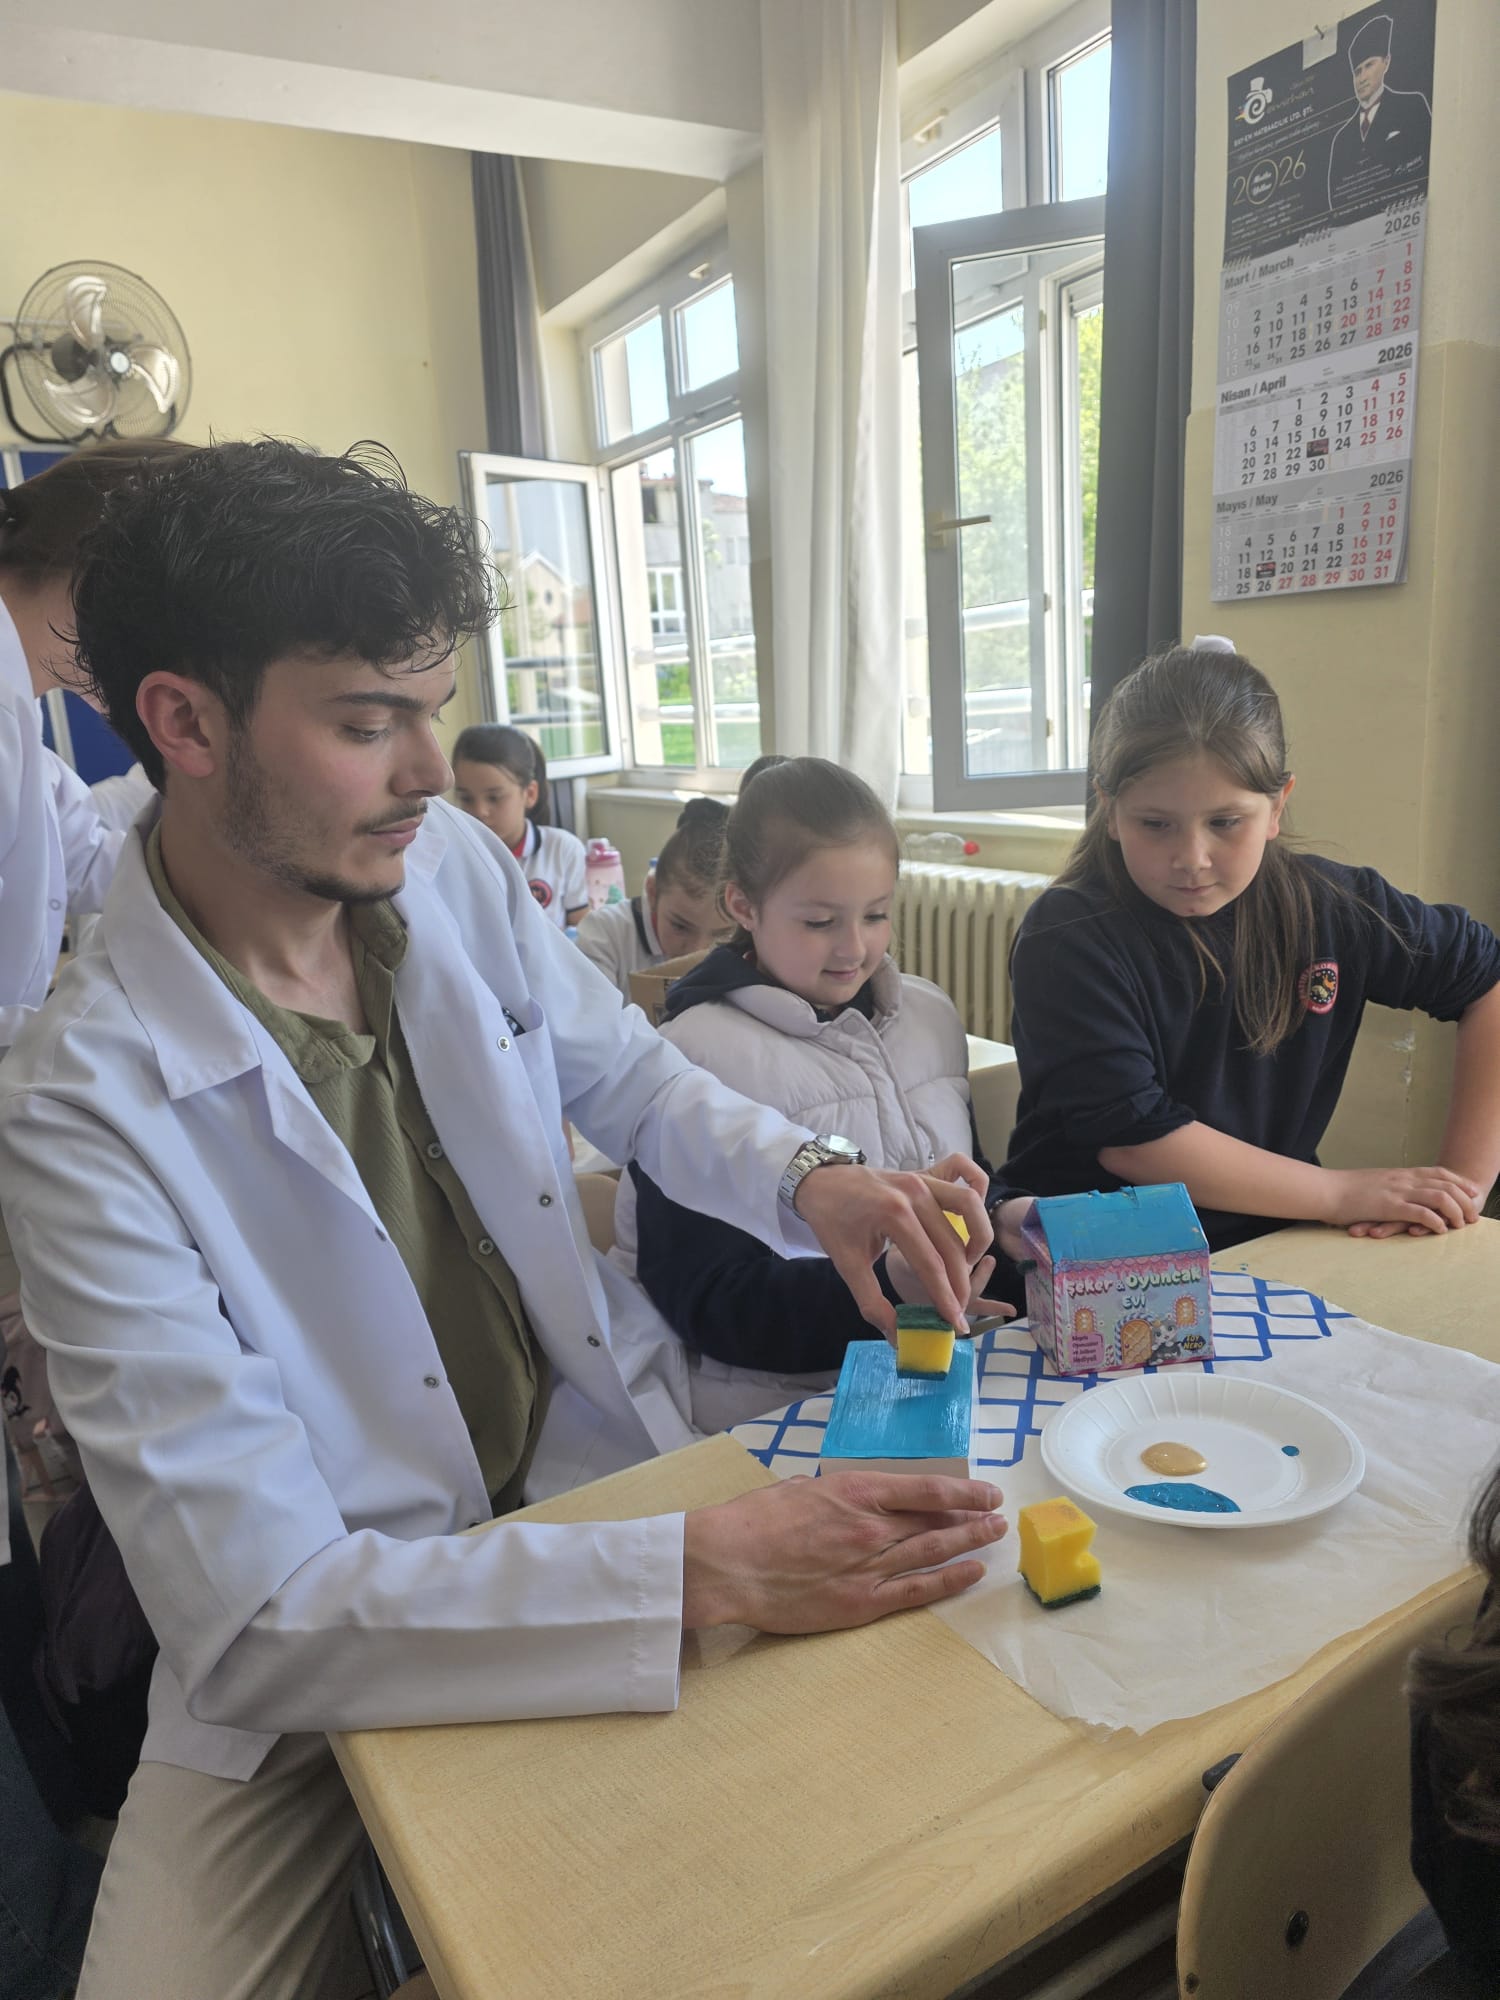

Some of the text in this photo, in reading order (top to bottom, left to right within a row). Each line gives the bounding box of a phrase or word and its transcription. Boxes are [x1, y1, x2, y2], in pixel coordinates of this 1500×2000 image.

[1233, 149, 1306, 205] 2026
[1384, 211, 1421, 236] 2026
[1406, 241, 1412, 256] 1
[1224, 272, 1249, 290] Mart
[1259, 256, 1294, 278] March
[1254, 309, 1261, 322] 2
[1276, 301, 1284, 315] 3
[1300, 293, 1308, 306] 4
[1325, 286, 1333, 300] 5
[1350, 277, 1358, 292] 6
[1376, 268, 1385, 283] 7
[1404, 260, 1412, 275] 8
[1254, 325, 1260, 338] 9
[1269, 318, 1283, 333] 10
[1293, 311, 1305, 326] 11
[1317, 303, 1332, 319] 12
[1343, 295, 1358, 311] 13
[1368, 287, 1384, 303] 14
[1395, 279, 1411, 295] 15
[1247, 342, 1260, 356] 16
[1269, 334, 1283, 349] 17
[1292, 327, 1306, 342] 18
[1317, 320, 1332, 336] 19
[1341, 312, 1357, 329] 20
[1367, 304, 1382, 321] 21
[1393, 296, 1410, 314] 22
[1290, 344, 1306, 360] 25
[1314, 338, 1331, 353] 26
[1340, 329, 1356, 346] 27
[1366, 321, 1382, 339] 28
[1392, 314, 1410, 332] 29
[1377, 341, 1412, 364] 2026
[1220, 387, 1251, 404] Nisan
[1259, 375, 1287, 394] April
[1296, 372, 1406, 410] 1 2 3 4 5
[1250, 390, 1406, 437] 6 7 8 9 10 11 12
[1244, 407, 1404, 454] 13 14 15 16 17 18 19
[1242, 456, 1256, 470] 20
[1263, 451, 1276, 465] 21
[1286, 446, 1301, 461] 22
[1335, 436, 1351, 451] 24
[1360, 431, 1377, 446] 25
[1386, 425, 1403, 440] 26
[1241, 458, 1325, 485] 27 28 29 30
[1369, 469, 1404, 488] 2026
[1216, 500, 1247, 514] Mayıs
[1256, 494, 1278, 506] May
[1339, 506, 1344, 519] 1
[1362, 502, 1370, 515] 2
[1388, 497, 1397, 511] 3
[1238, 552, 1250, 564] 11
[1260, 549, 1274, 561] 12
[1282, 546, 1295, 559] 13
[1304, 542, 1319, 555] 14
[1328, 539, 1343, 552] 15
[1353, 535, 1368, 549] 16
[1378, 531, 1394, 545] 17
[1244, 536, 1252, 548] 4
[1267, 533, 1275, 546] 5
[1290, 530, 1297, 542] 6
[1312, 526, 1320, 539] 7
[1336, 522, 1345, 535] 8
[1361, 518, 1369, 531] 9
[1379, 515, 1396, 529] 10
[1236, 582, 1250, 594] 25
[1257, 580, 1272, 592] 26
[1278, 576, 1293, 590] 27
[1301, 573, 1317, 587] 28
[1324, 571, 1341, 585] 29
[1349, 568, 1365, 582] 30
[1374, 565, 1390, 580] 31
[1238, 567, 1251, 579] 18
[1280, 561, 1294, 574] 20
[1302, 558, 1316, 572] 21
[1326, 555, 1342, 569] 22
[1351, 552, 1367, 566] 23
[1375, 549, 1392, 563] 24
[1126, 1266, 1203, 1291] Oyuncak
